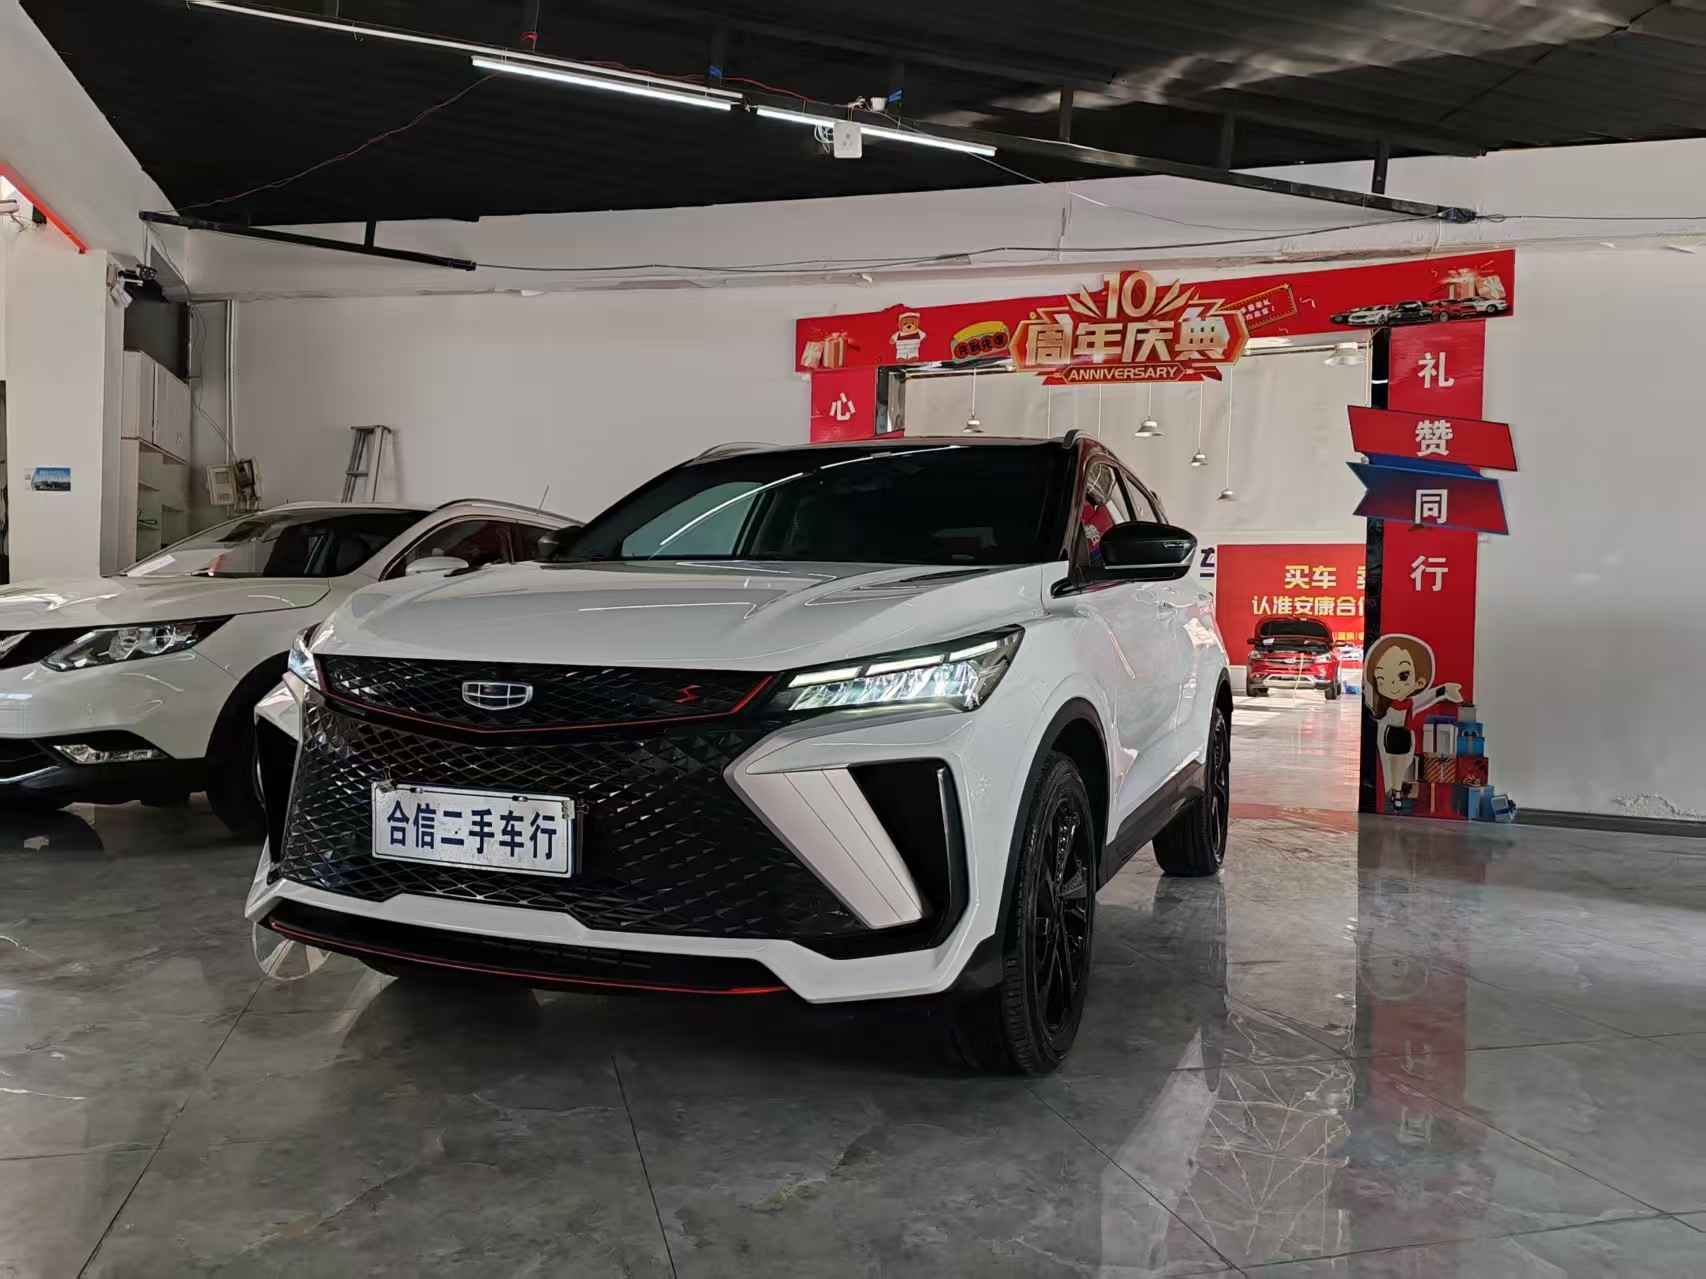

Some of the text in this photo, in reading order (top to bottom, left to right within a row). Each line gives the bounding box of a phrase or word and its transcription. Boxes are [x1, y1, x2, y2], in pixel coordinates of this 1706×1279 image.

[1102, 271, 1157, 319] 10
[1026, 307, 1230, 366] 周年庆典
[1067, 366, 1178, 381] ANNIVERSARY
[829, 392, 856, 421] 心
[385, 799, 558, 861] 合信二手车行
